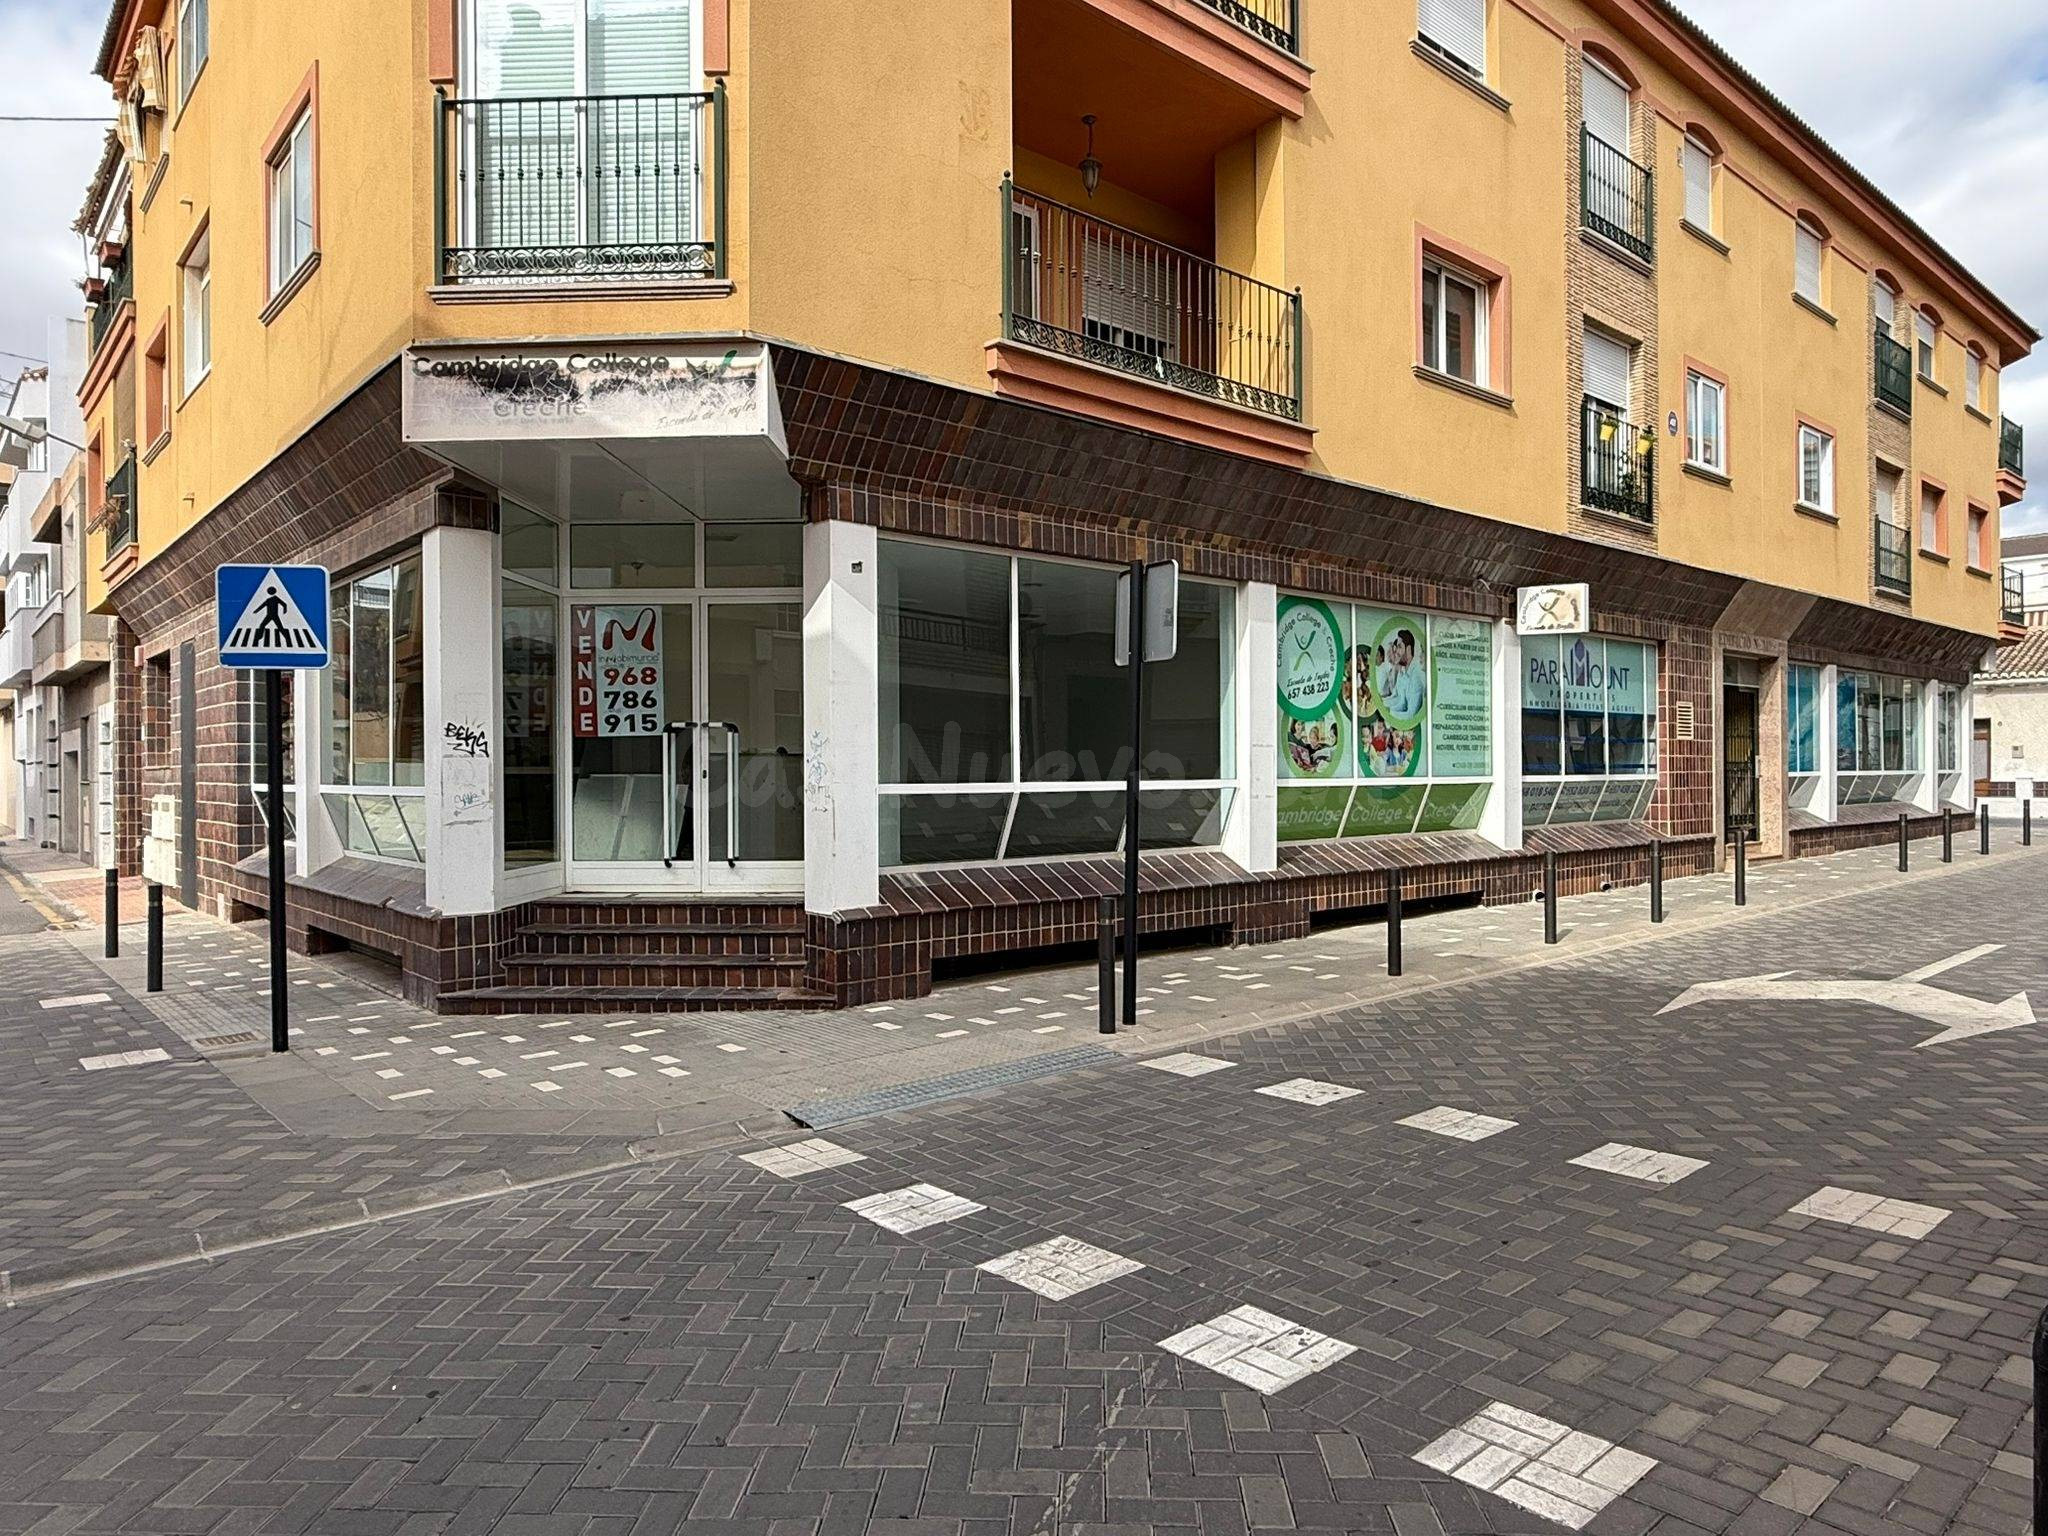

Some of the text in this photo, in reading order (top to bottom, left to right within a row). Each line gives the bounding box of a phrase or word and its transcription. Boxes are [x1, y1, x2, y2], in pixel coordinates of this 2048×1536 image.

[566, 352, 670, 377] College
[1296, 612, 1322, 629] College
[576, 609, 594, 732] VENDE
[1530, 639, 1630, 691] PARAMOUNT
[604, 666, 657, 686] 968
[604, 690, 658, 709] 786
[1287, 681, 1330, 700] 657 438 223
[1549, 689, 1616, 702] PROPERTIS
[1584, 702, 1608, 711] ESTAT
[604, 713, 658, 733] 915
[1277, 805, 1342, 826] ambridge
[1351, 804, 1403, 825] College
